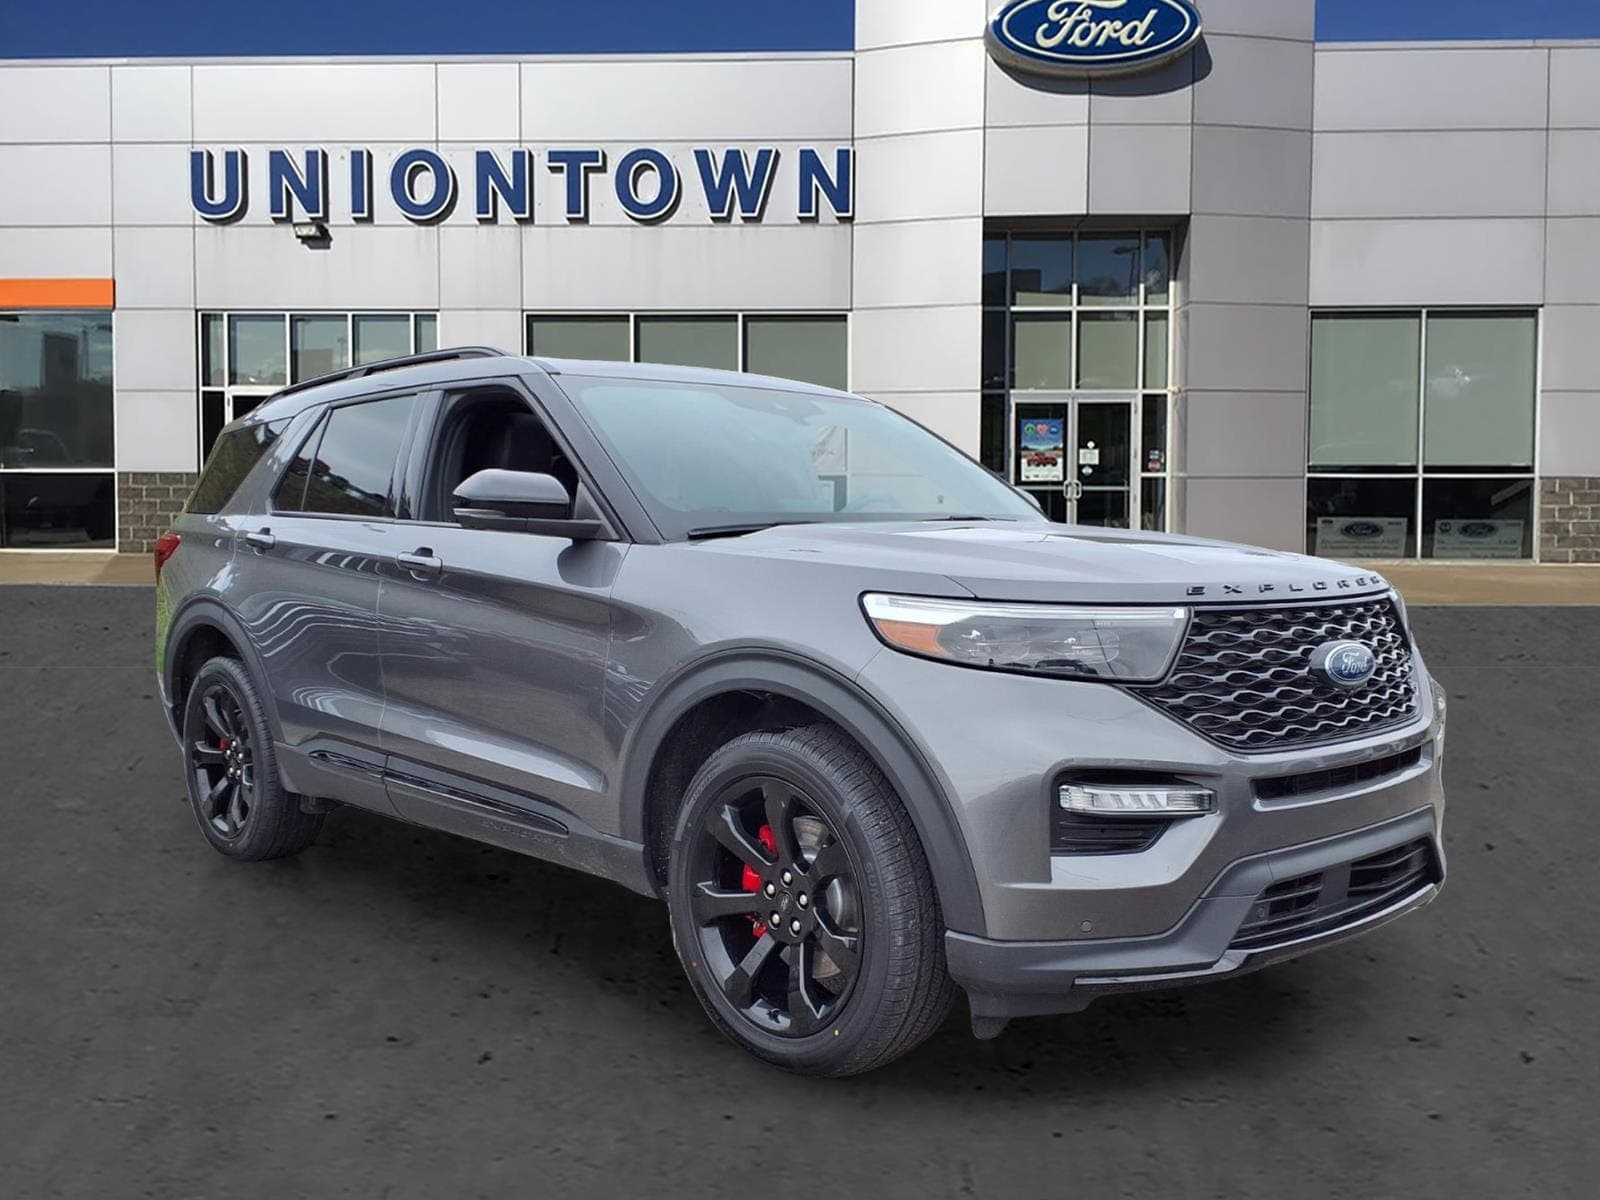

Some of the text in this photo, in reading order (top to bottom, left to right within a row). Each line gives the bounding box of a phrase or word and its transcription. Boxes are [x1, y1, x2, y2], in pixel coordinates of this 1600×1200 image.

[1036, 0, 1157, 48] Ford
[190, 146, 855, 222] UNIONTOWN
[1186, 576, 1380, 596] EXPLORER
[1341, 651, 1370, 674] Ford
